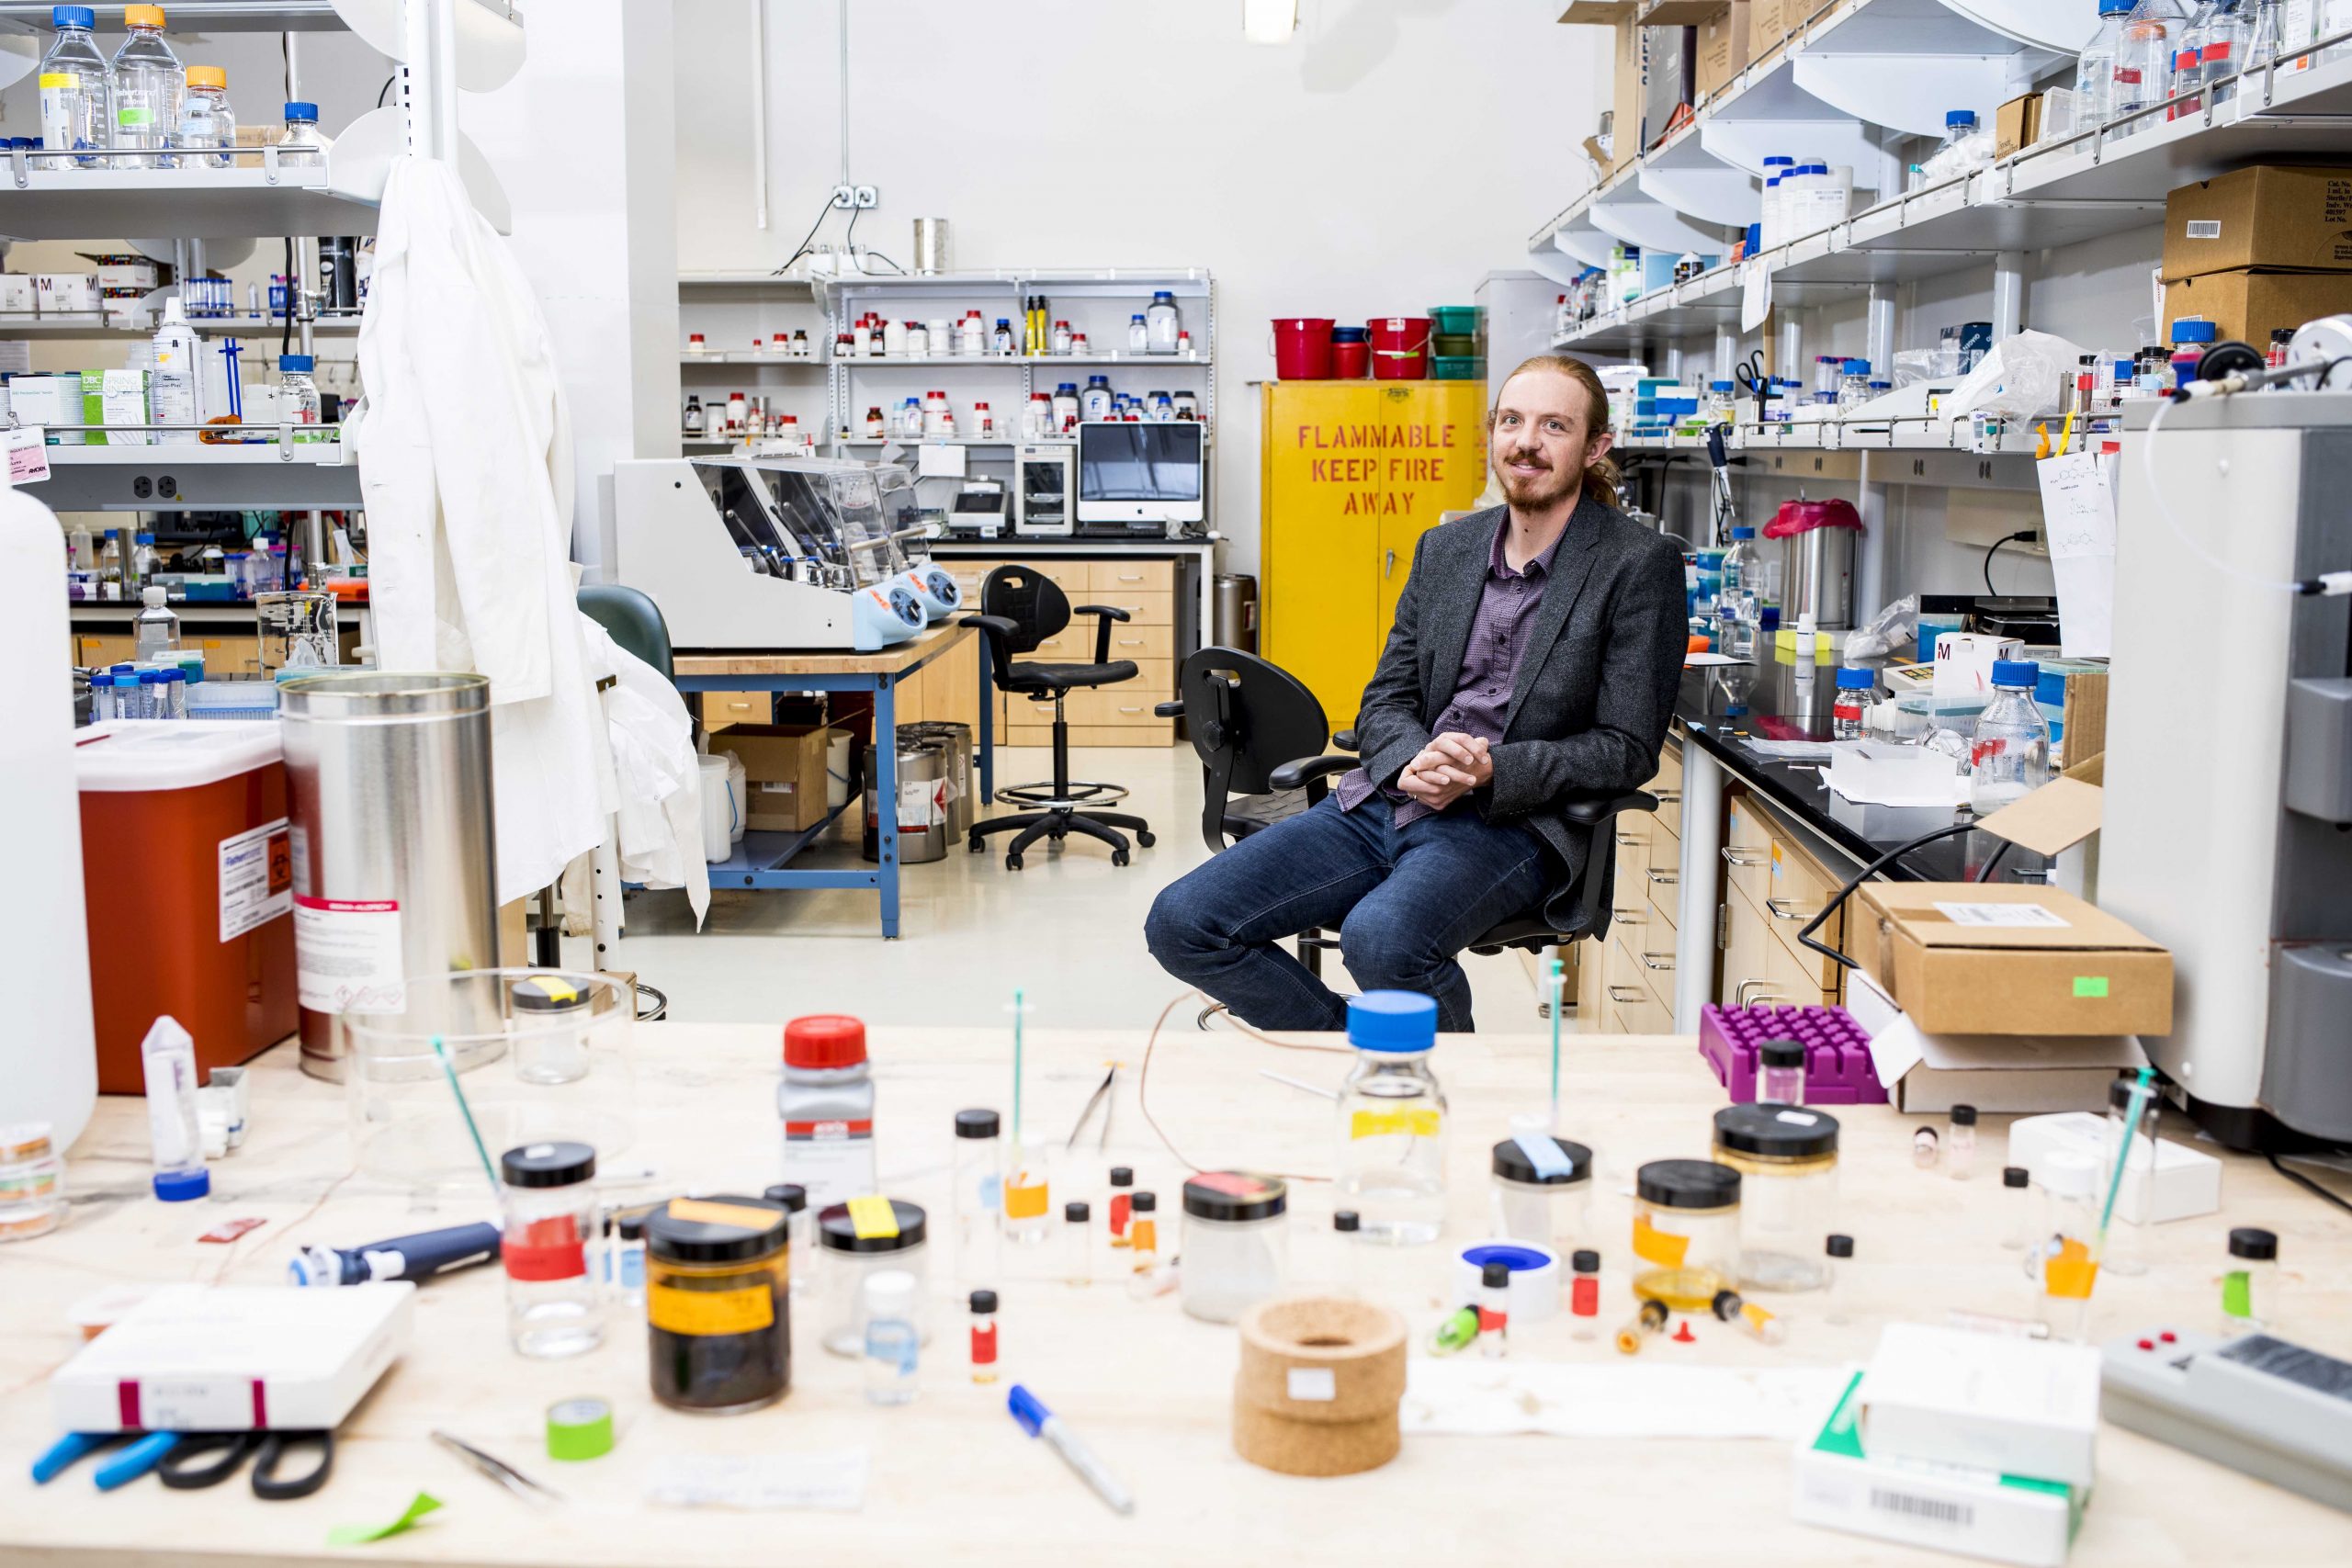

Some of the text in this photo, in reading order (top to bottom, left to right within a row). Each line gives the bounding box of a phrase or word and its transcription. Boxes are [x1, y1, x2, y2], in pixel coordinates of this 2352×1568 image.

[40, 277, 52, 291] M
[1298, 424, 1455, 449] FLAMMABLE
[1312, 458, 1444, 482] KEEP FIRE
[1343, 492, 1415, 515] AWAY
[1938, 642, 1951, 660] M
